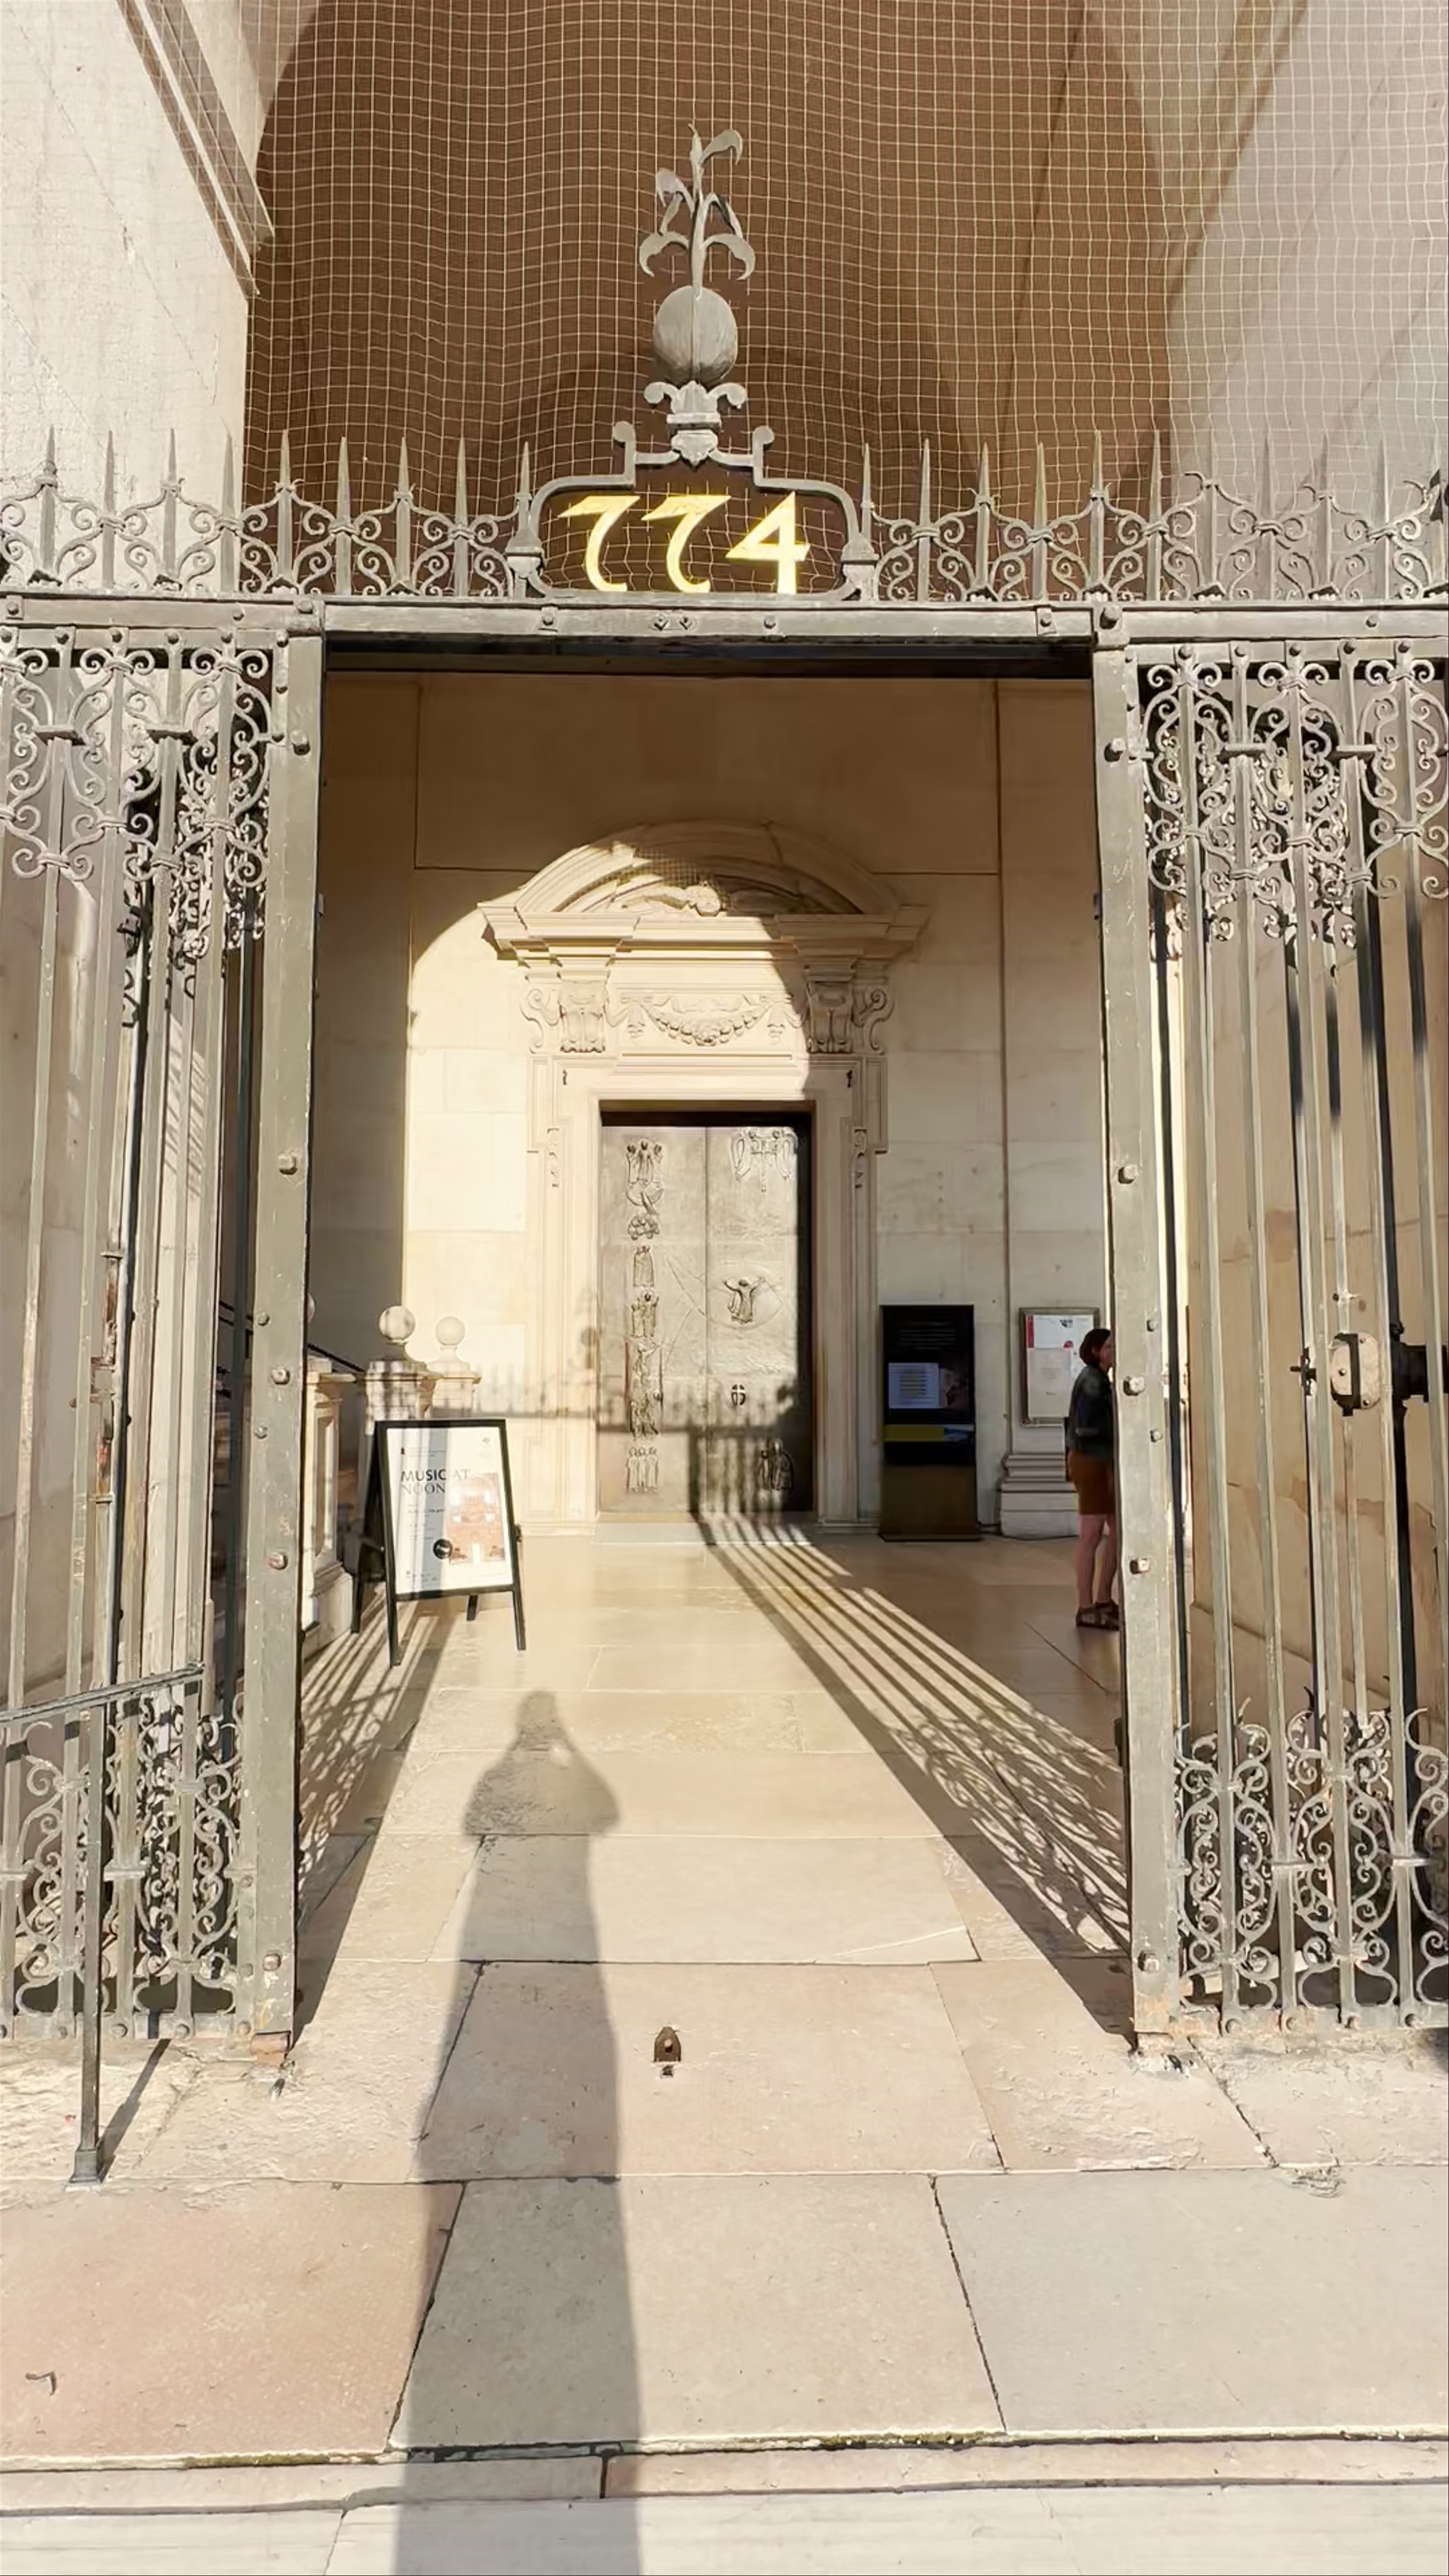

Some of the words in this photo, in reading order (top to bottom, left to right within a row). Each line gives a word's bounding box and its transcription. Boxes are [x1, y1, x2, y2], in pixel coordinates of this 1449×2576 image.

[558, 491, 811, 594] 774
[401, 1469, 446, 1481] MUSIC
[454, 1469, 470, 1480] AT
[401, 1483, 446, 1494] NOON
